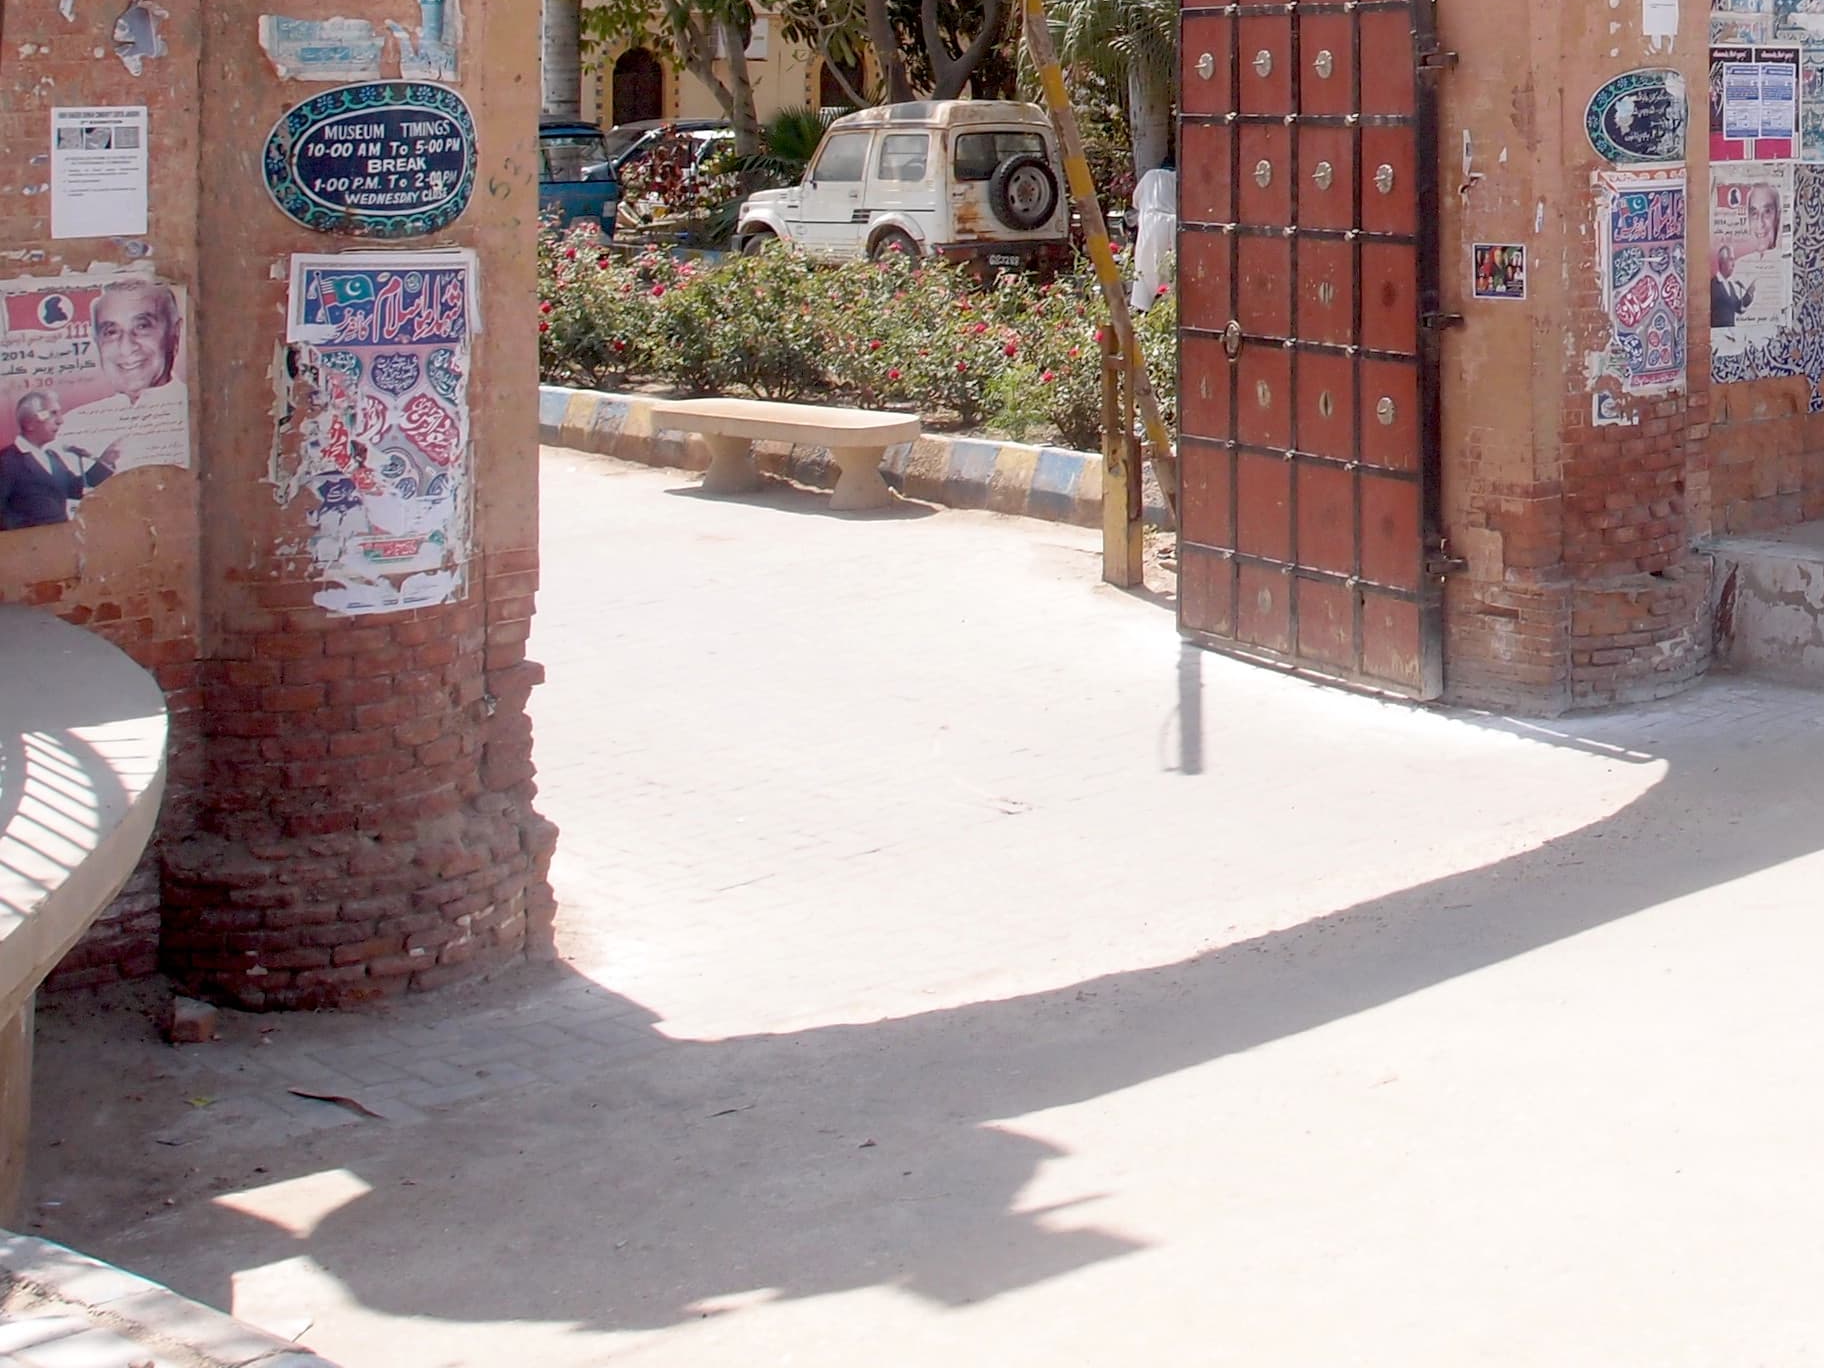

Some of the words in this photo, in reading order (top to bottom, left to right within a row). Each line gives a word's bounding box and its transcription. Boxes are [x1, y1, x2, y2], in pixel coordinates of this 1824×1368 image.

[324, 123, 385, 140] MUSEUM
[401, 119, 450, 138] TIMINGS
[307, 142, 353, 158] 10-00
[357, 141, 381, 157] AM
[390, 141, 407, 156] To
[415, 138, 443, 155] 5-00
[445, 137, 461, 152] PM
[367, 157, 427, 173] BREAK
[313, 177, 349, 192] 1-00
[388, 175, 408, 189] To
[345, 191, 419, 205] WEDNESDAY
[1, 349, 35, 362] 2014
